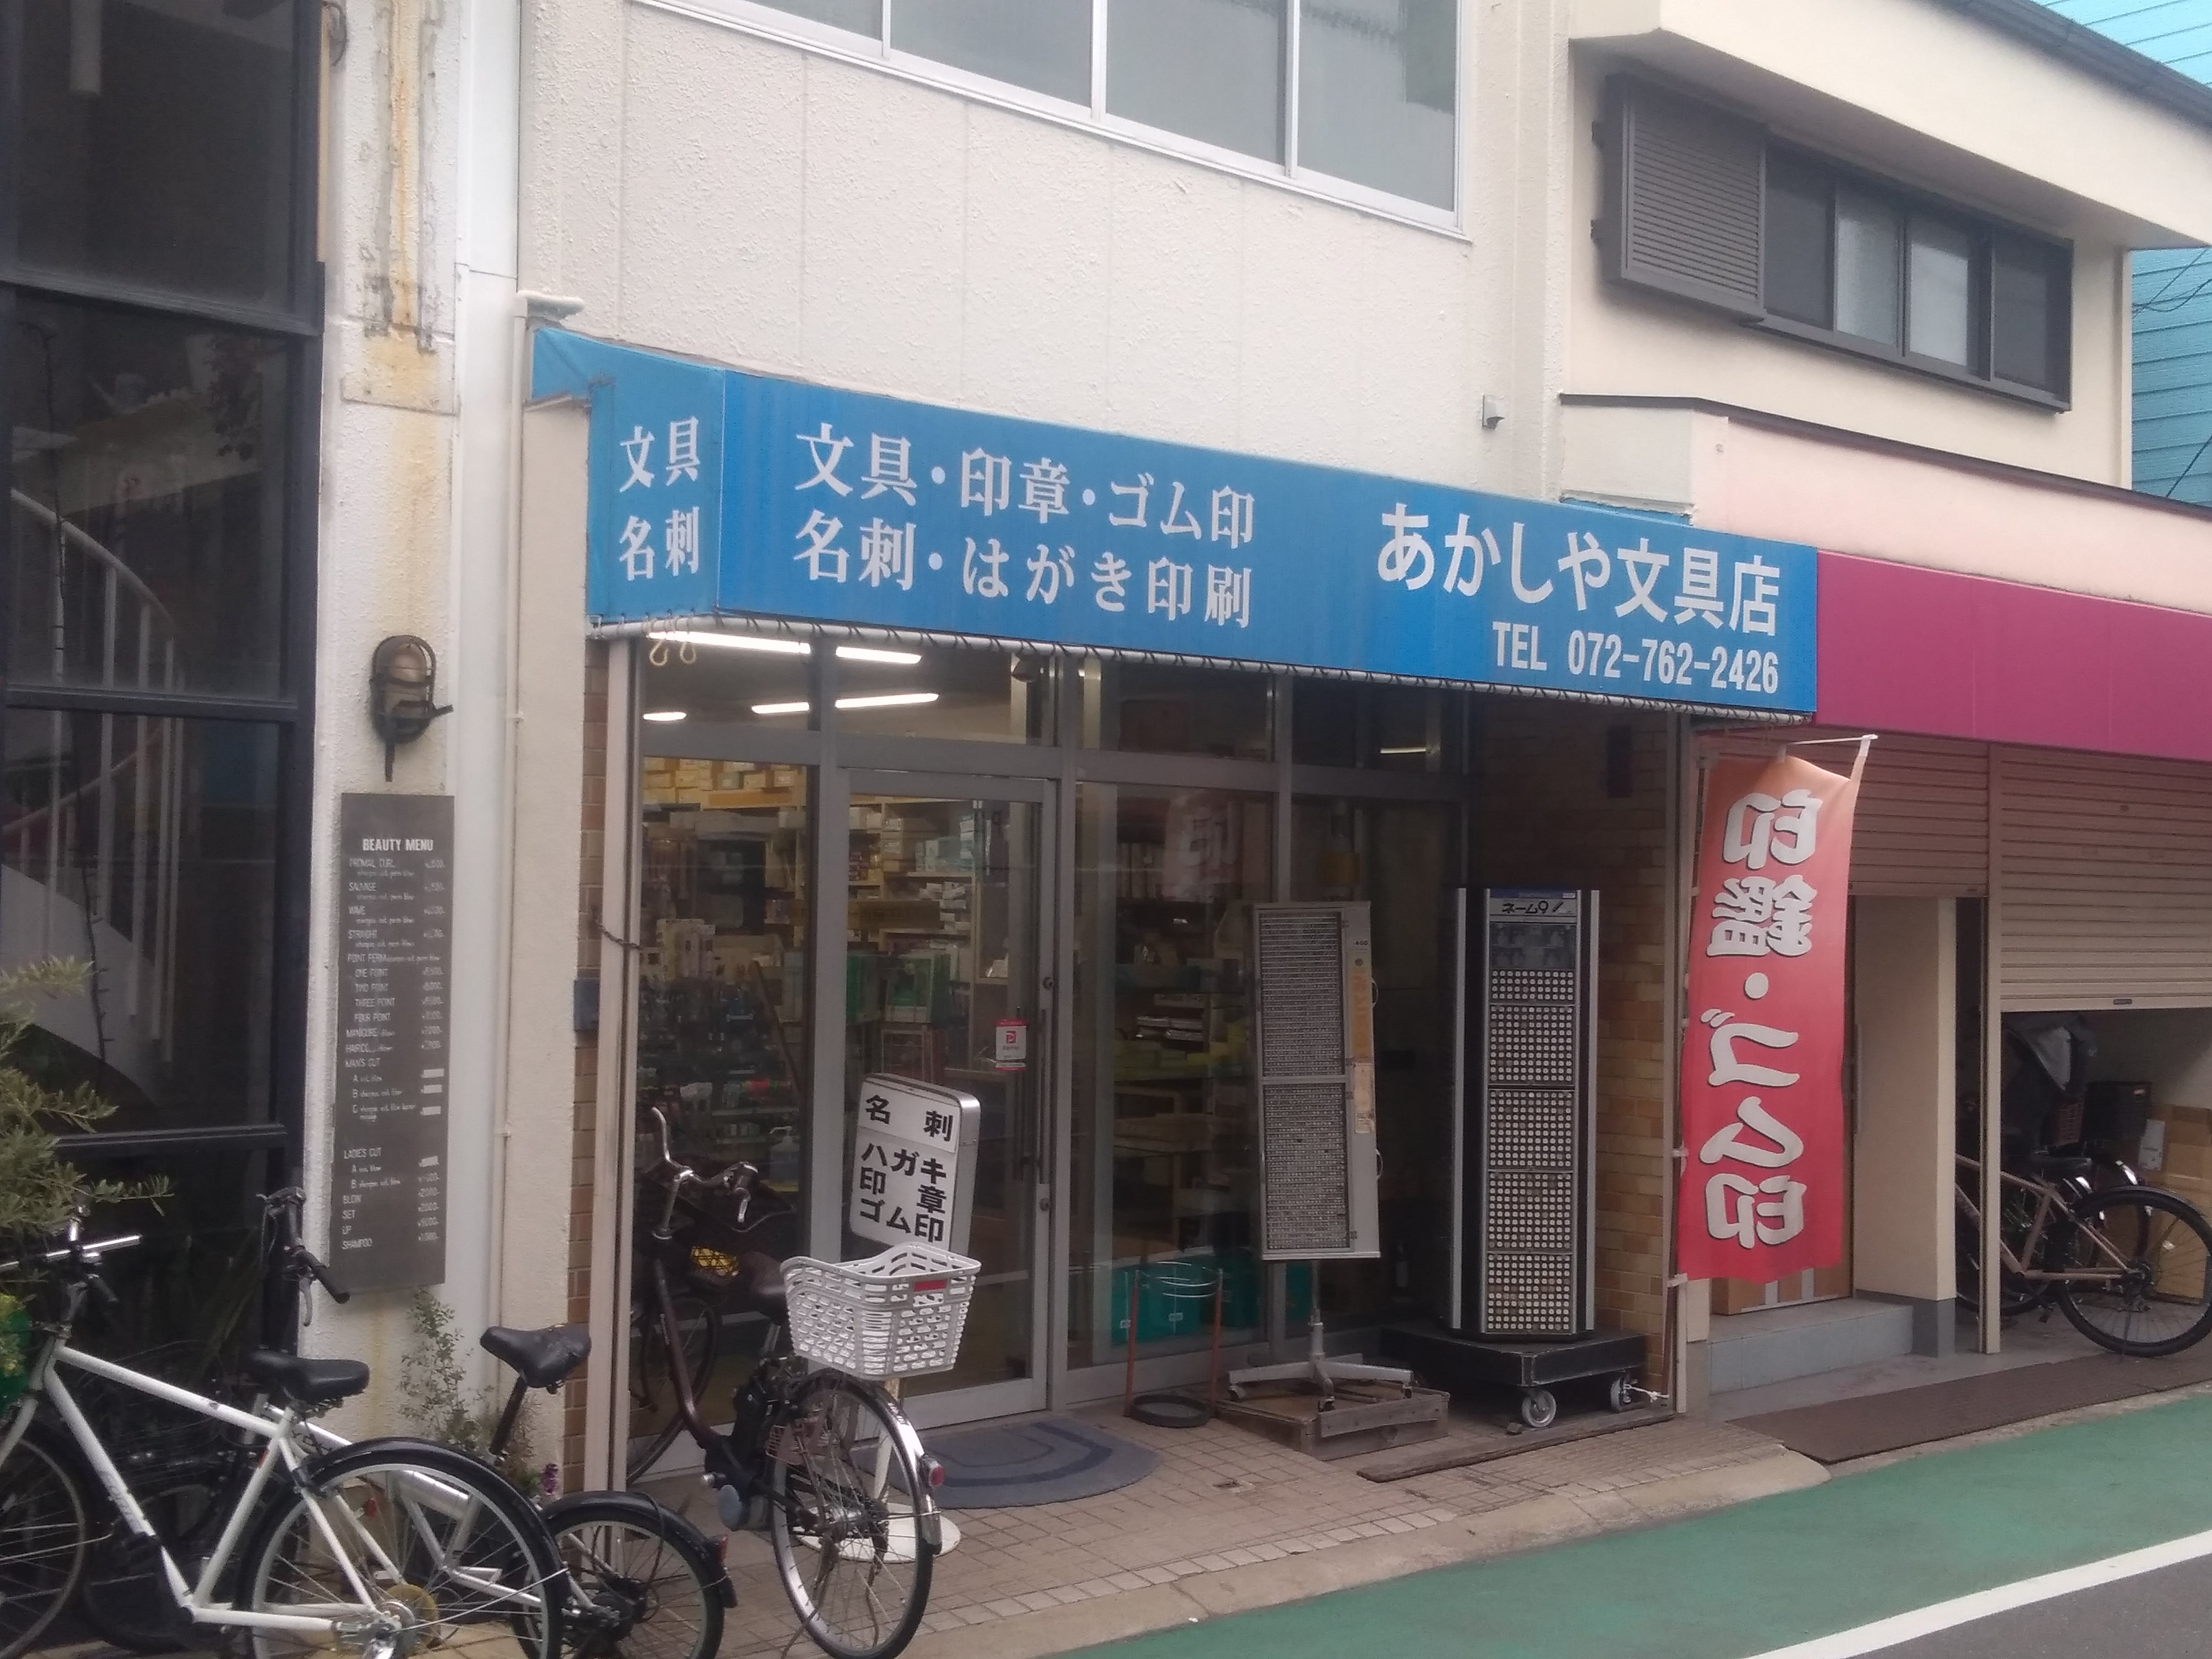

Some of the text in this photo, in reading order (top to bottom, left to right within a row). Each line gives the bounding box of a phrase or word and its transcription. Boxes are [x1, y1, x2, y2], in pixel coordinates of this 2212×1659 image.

[619, 416, 700, 492] 文具
[795, 422, 1255, 549] 文具・印章・ゴム印
[619, 506, 700, 581] 名刺
[793, 509, 1252, 628] 名刺・はがき印刷
[1378, 502, 1780, 636] あかしや文具店
[1493, 621, 1779, 694] TEL 072-762-2426
[363, 839, 434, 851] BEAUTY MENU
[865, 1094, 954, 1142] 名刺
[861, 1143, 947, 1185] ハガキ
[342, 1209, 355, 1219] SET
[860, 1166, 947, 1214] 印章
[342, 1225, 351, 1235] UP
[342, 1237, 373, 1250] SHAMPOO
[860, 1197, 945, 1243] ゴム印
